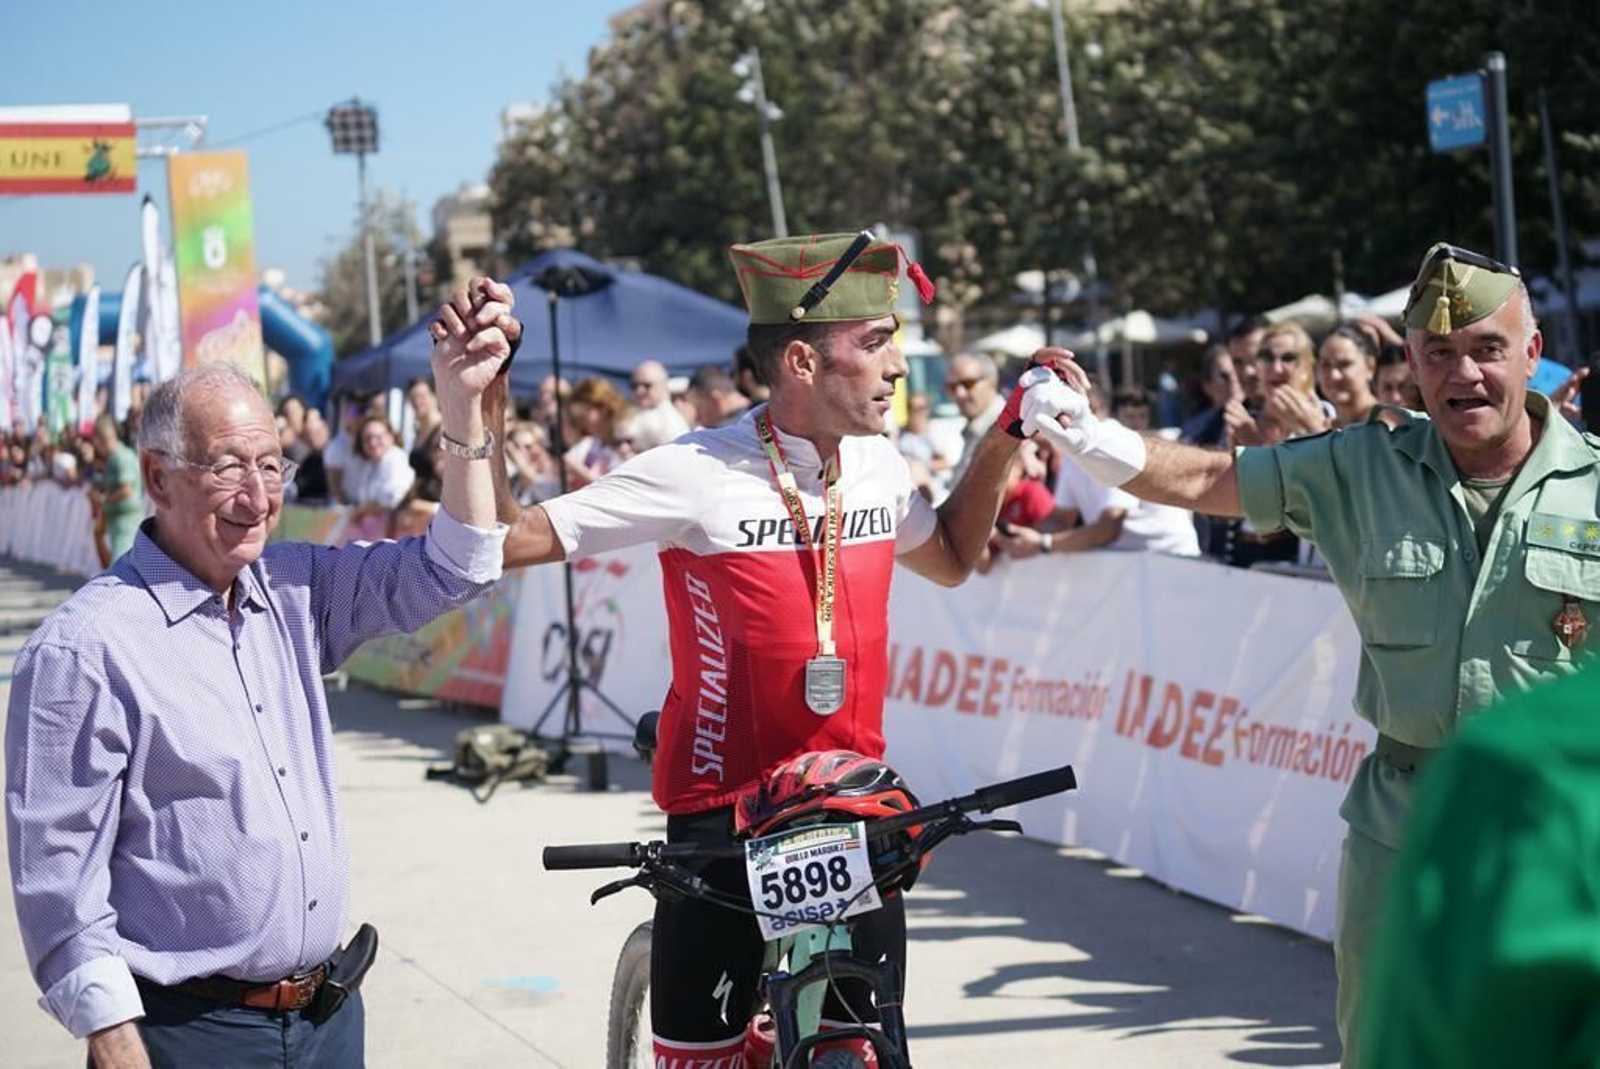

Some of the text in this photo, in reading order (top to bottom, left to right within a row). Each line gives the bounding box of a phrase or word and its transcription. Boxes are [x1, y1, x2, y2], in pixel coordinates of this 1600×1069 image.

[736, 507, 891, 547] SPECILIZED
[685, 572, 727, 781] SPECIALIZED
[1233, 709, 1367, 783] Formación
[761, 855, 852, 910] 5898
